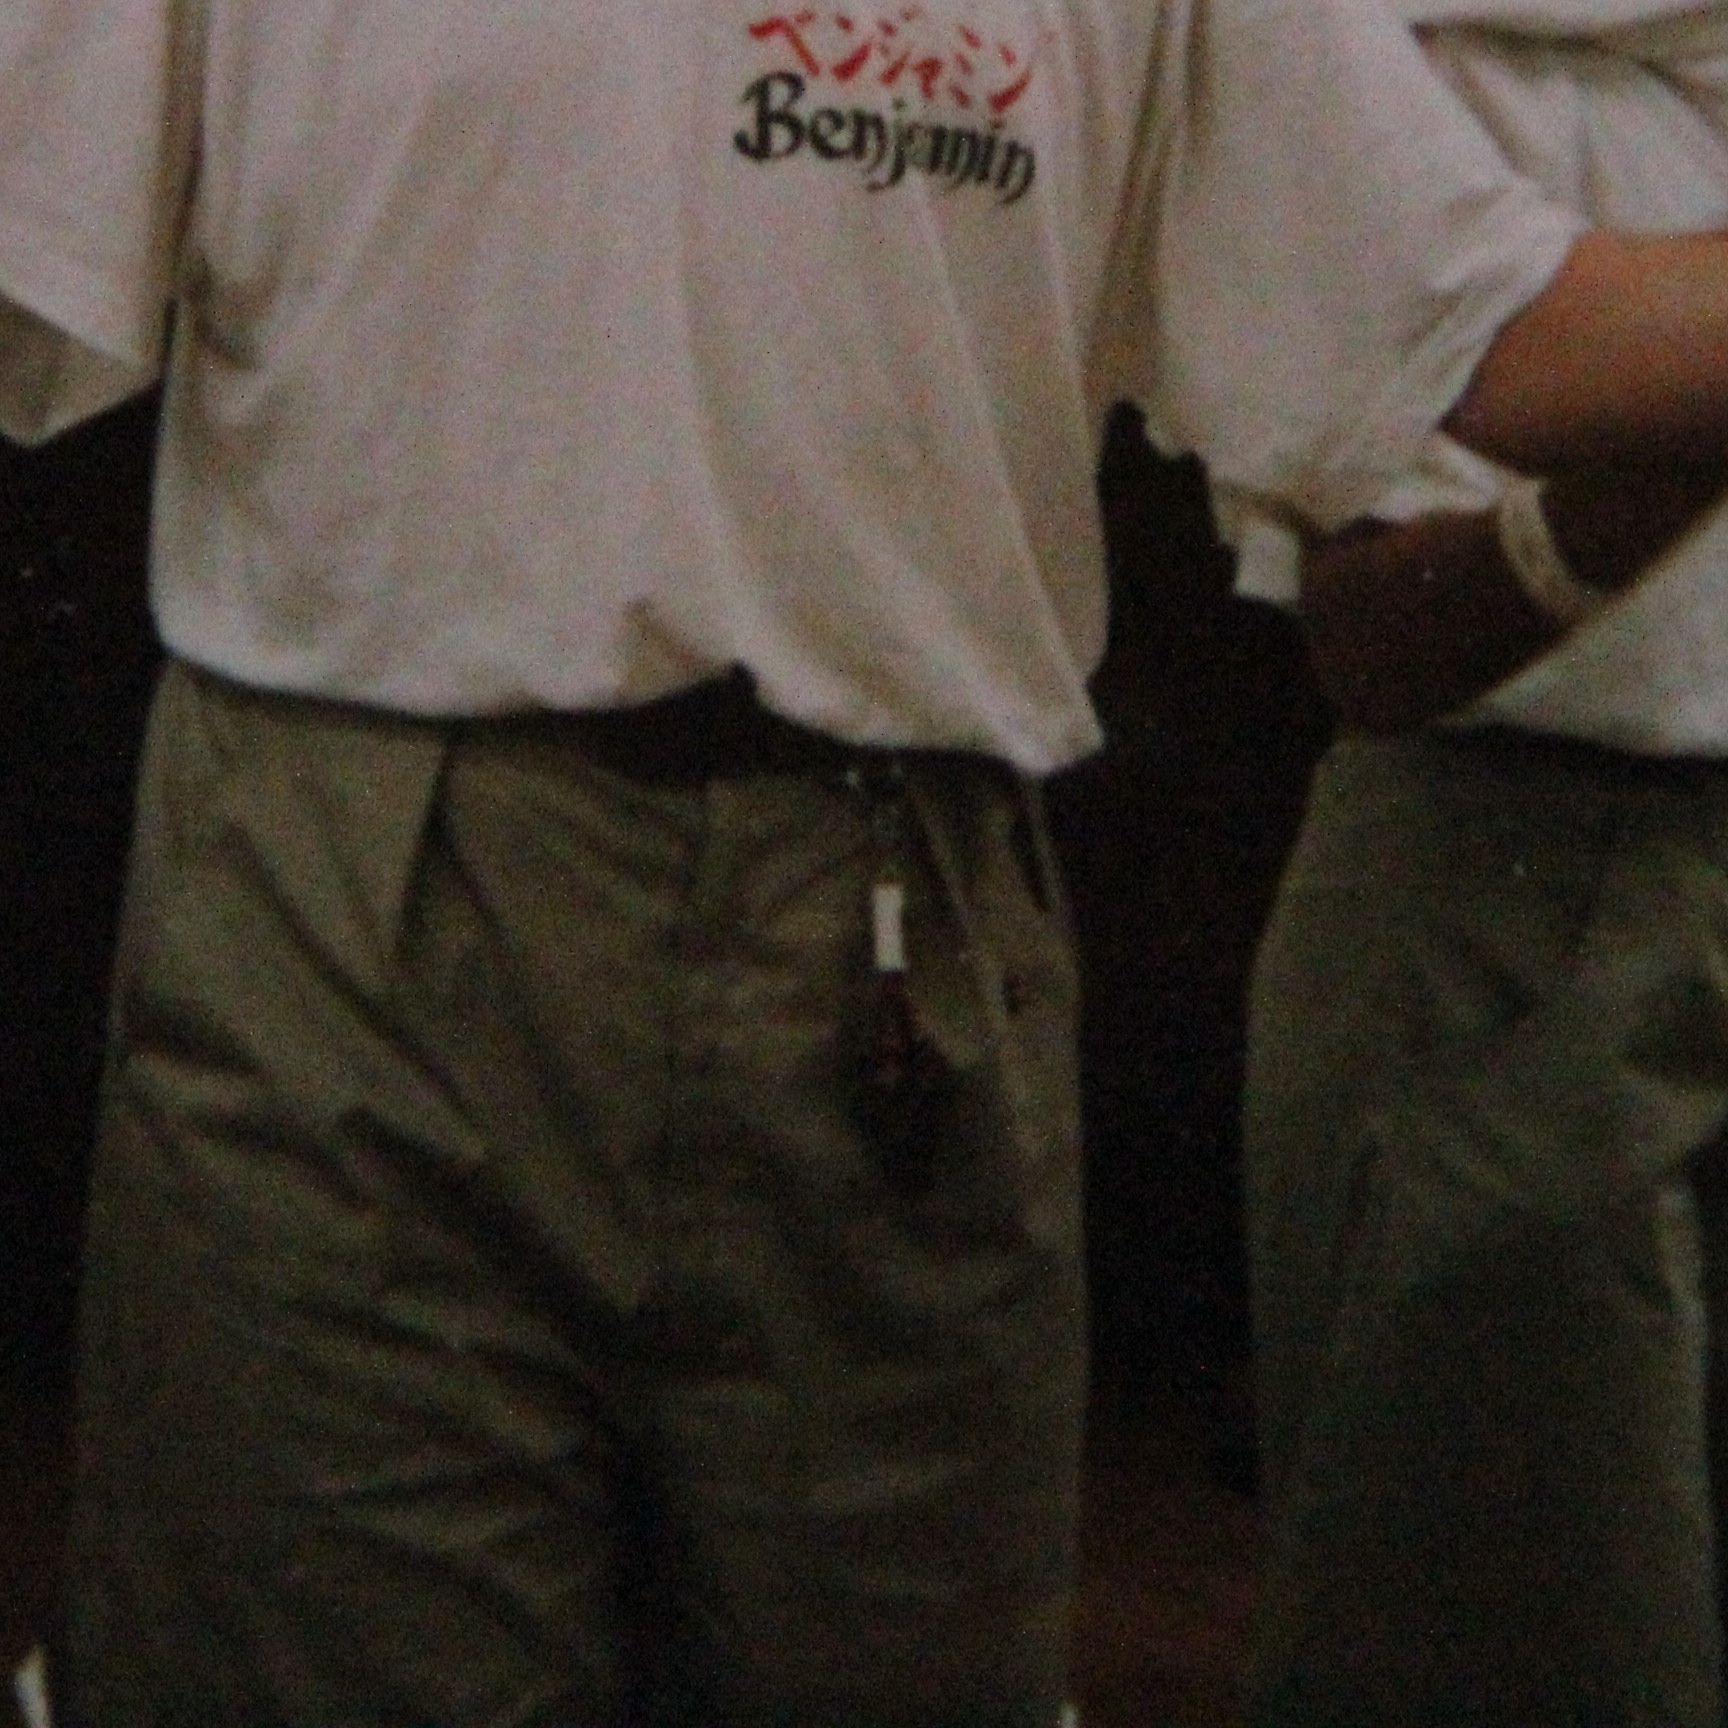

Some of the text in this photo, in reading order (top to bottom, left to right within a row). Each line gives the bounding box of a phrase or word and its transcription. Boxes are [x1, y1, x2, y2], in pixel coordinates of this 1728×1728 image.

[748, 5, 1032, 114] ベンジャミン
[735, 72, 1036, 204] Benjamin
